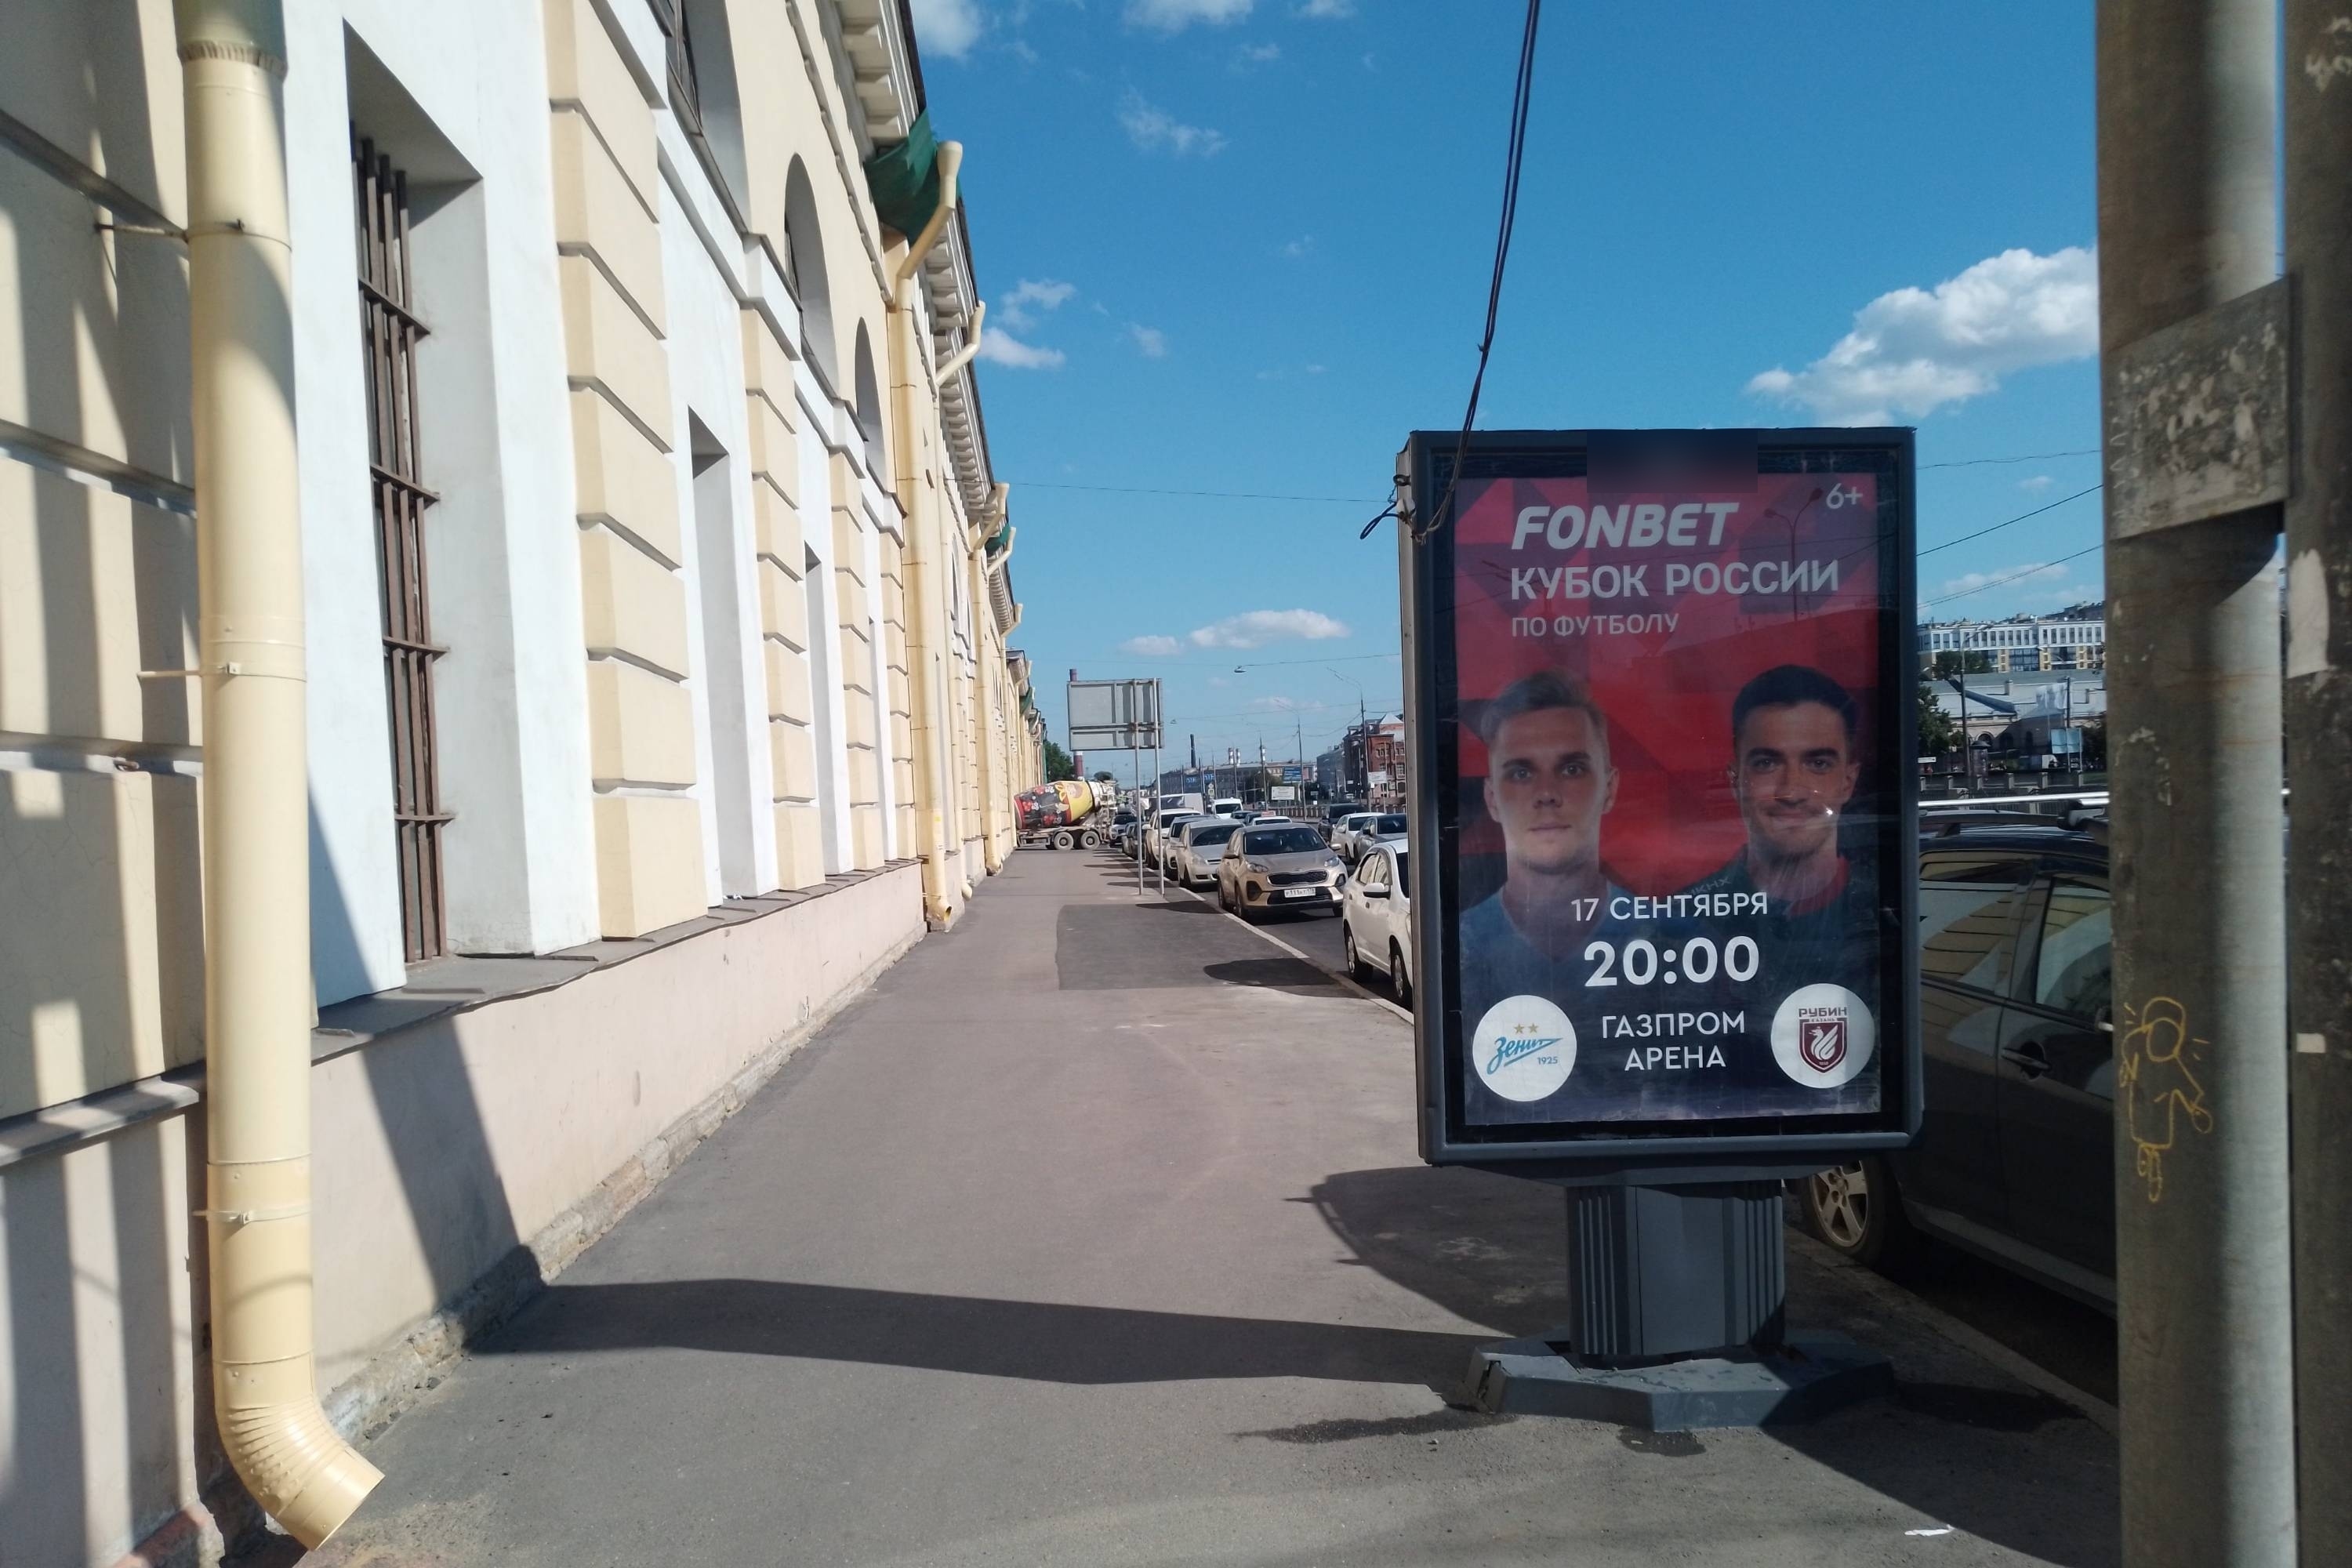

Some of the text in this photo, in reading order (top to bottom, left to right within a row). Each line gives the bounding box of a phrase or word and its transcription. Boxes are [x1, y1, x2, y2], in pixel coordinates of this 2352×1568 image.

[1826, 482, 1864, 510] 6+
[1512, 502, 1740, 550] FONBET
[1511, 560, 1838, 601] КУБОК РОССИИ
[1512, 613, 1679, 637] ПО ФУТБОЛУ
[1571, 891, 1768, 921] 17 СЕНТЯБРЯ
[1584, 935, 1759, 987] 20:00
[1602, 1011, 1744, 1039] ГАЗПРОМ
[1798, 1007, 1848, 1018] РУБИН
[1537, 1056, 1559, 1065] 1925
[1624, 1045, 1726, 1071] АРЕНА
